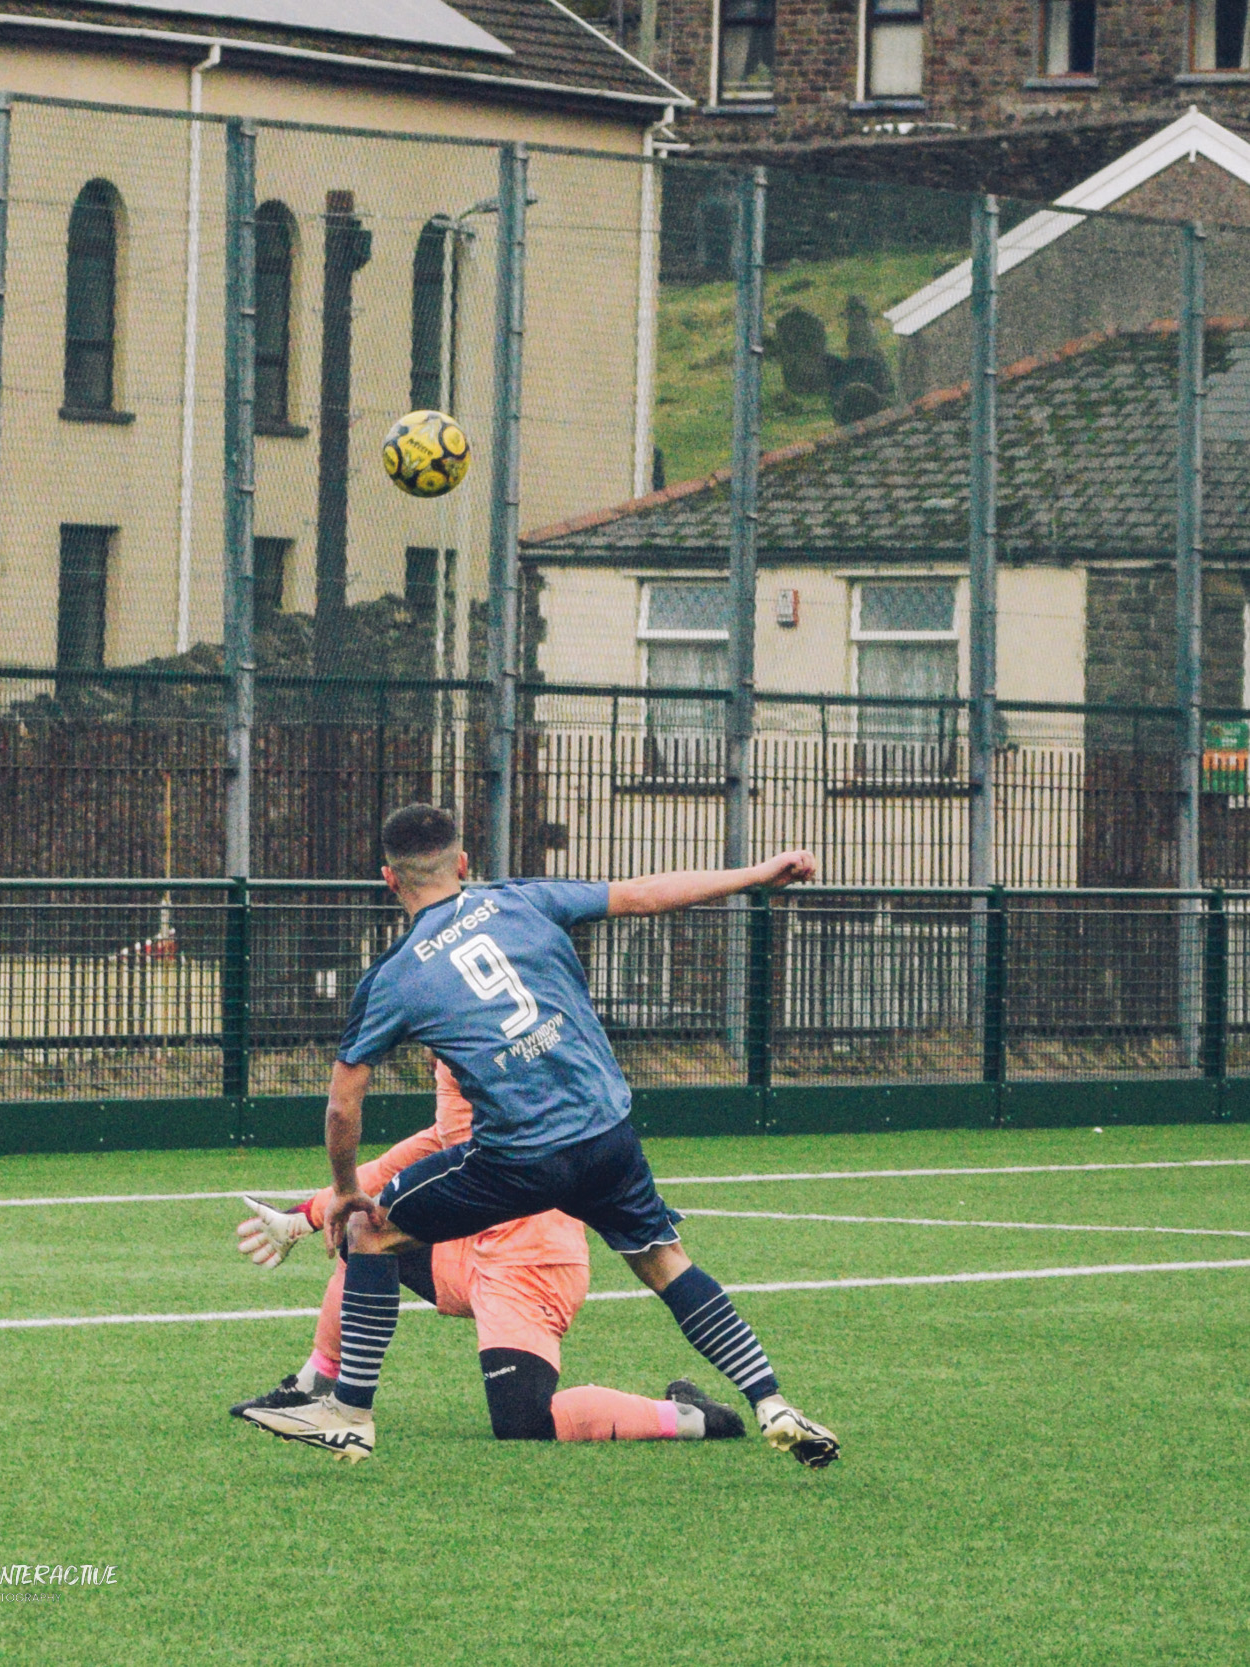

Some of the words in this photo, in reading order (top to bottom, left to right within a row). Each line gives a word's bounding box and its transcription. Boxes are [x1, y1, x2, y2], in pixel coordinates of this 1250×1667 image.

[413, 898, 500, 963] Everest
[449, 932, 539, 1040] 9
[523, 1012, 564, 1047] WINDOW
[523, 1029, 561, 1063] SYSTEMS
